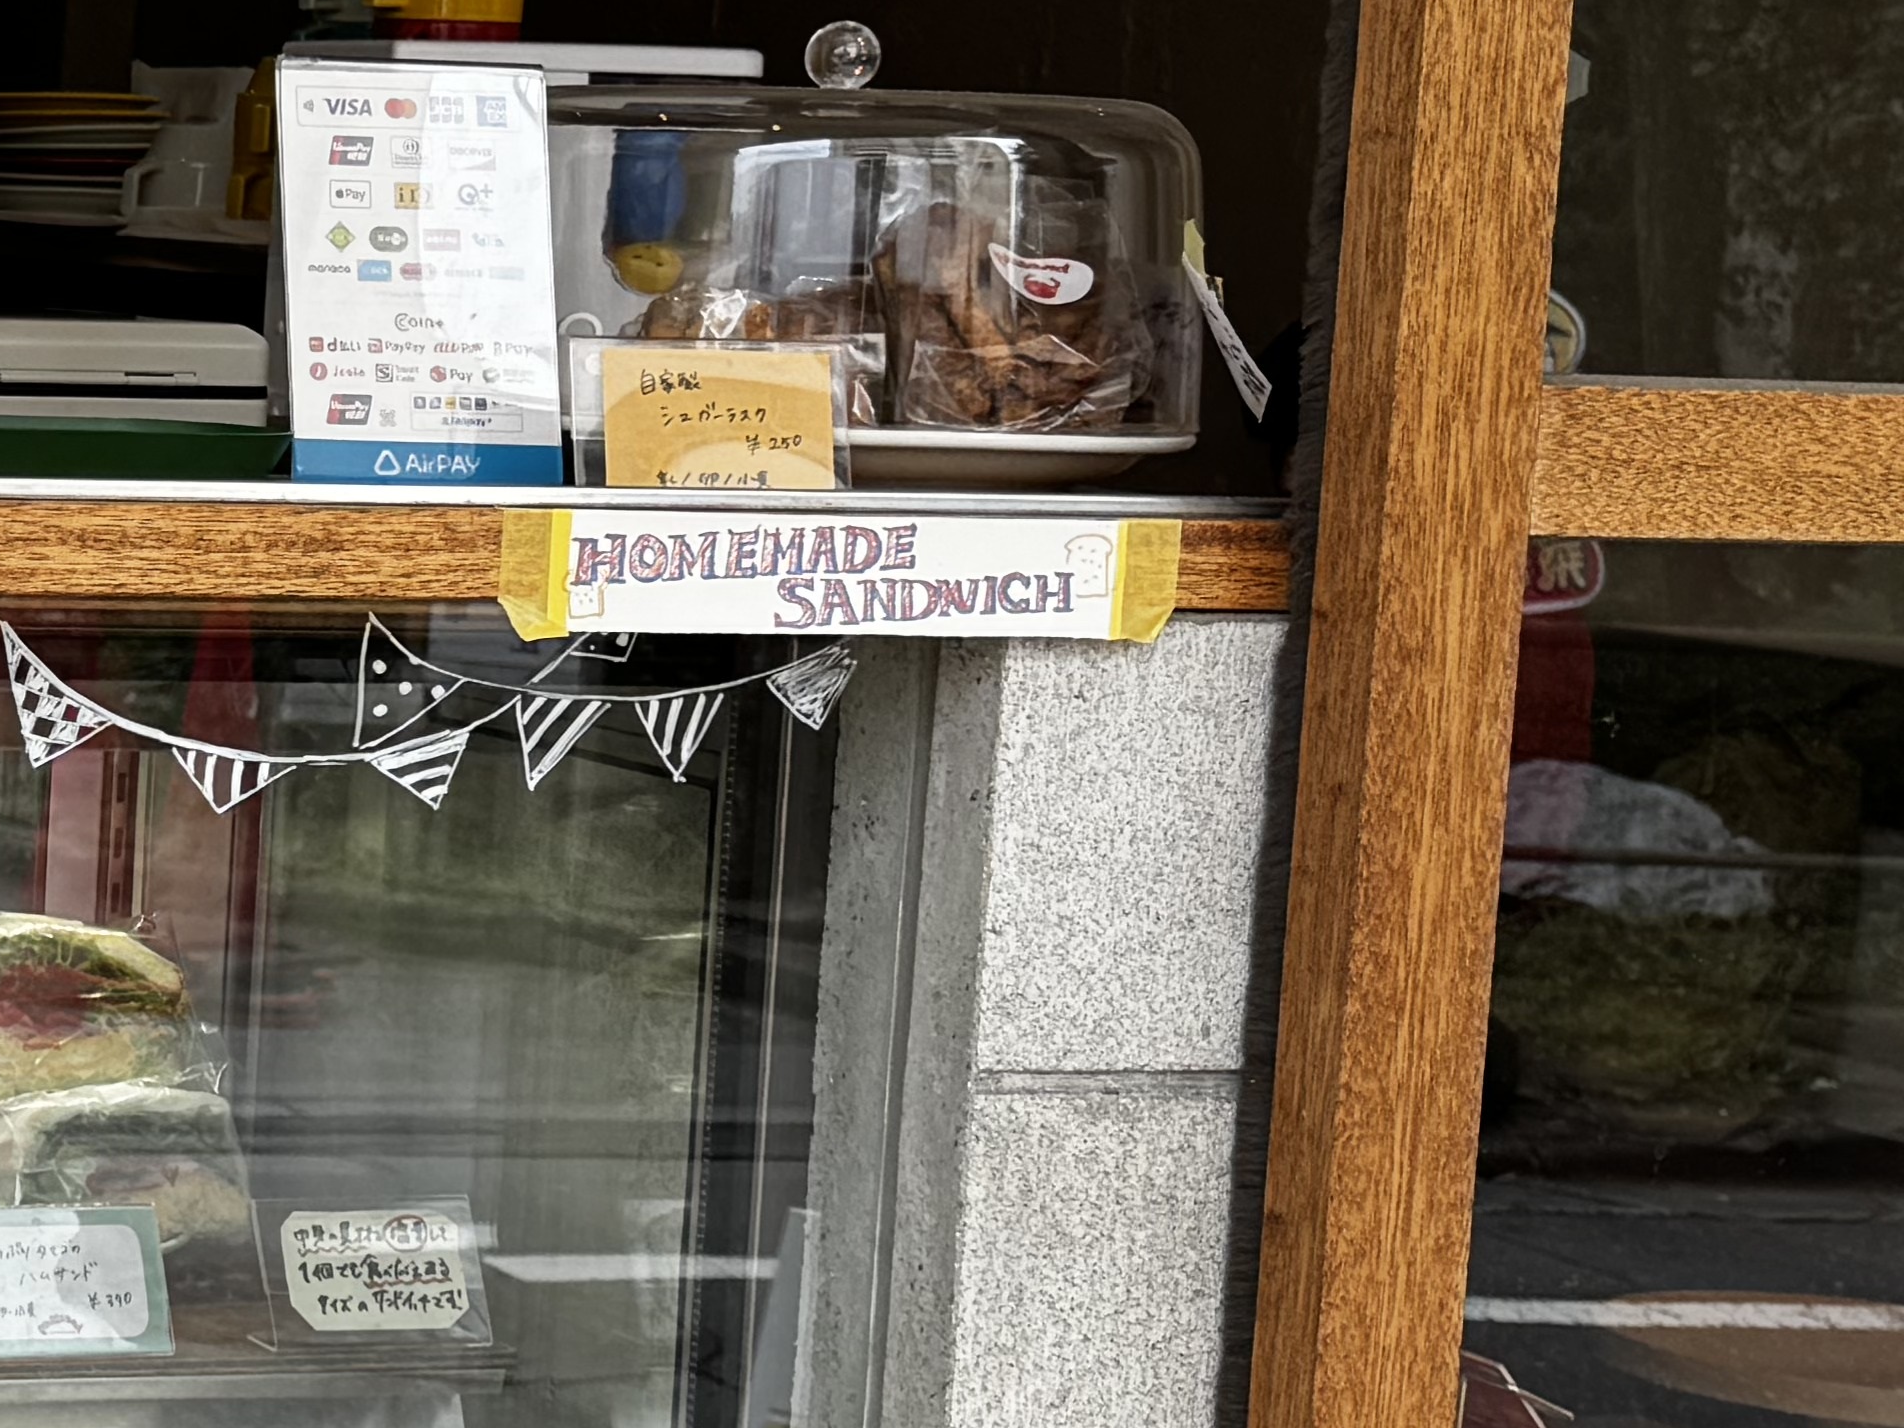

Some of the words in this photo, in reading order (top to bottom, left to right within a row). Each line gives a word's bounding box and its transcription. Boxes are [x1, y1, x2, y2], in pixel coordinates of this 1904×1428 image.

[322, 98, 373, 116] VISA
[345, 188, 366, 203] Pay
[660, 401, 766, 426] シュガーラスク
[405, 453, 480, 474] AirPAY
[571, 523, 917, 586] HOMEMADE
[775, 571, 1074, 629] SANDWICH
[20, 1261, 98, 1286] ハムサンド
